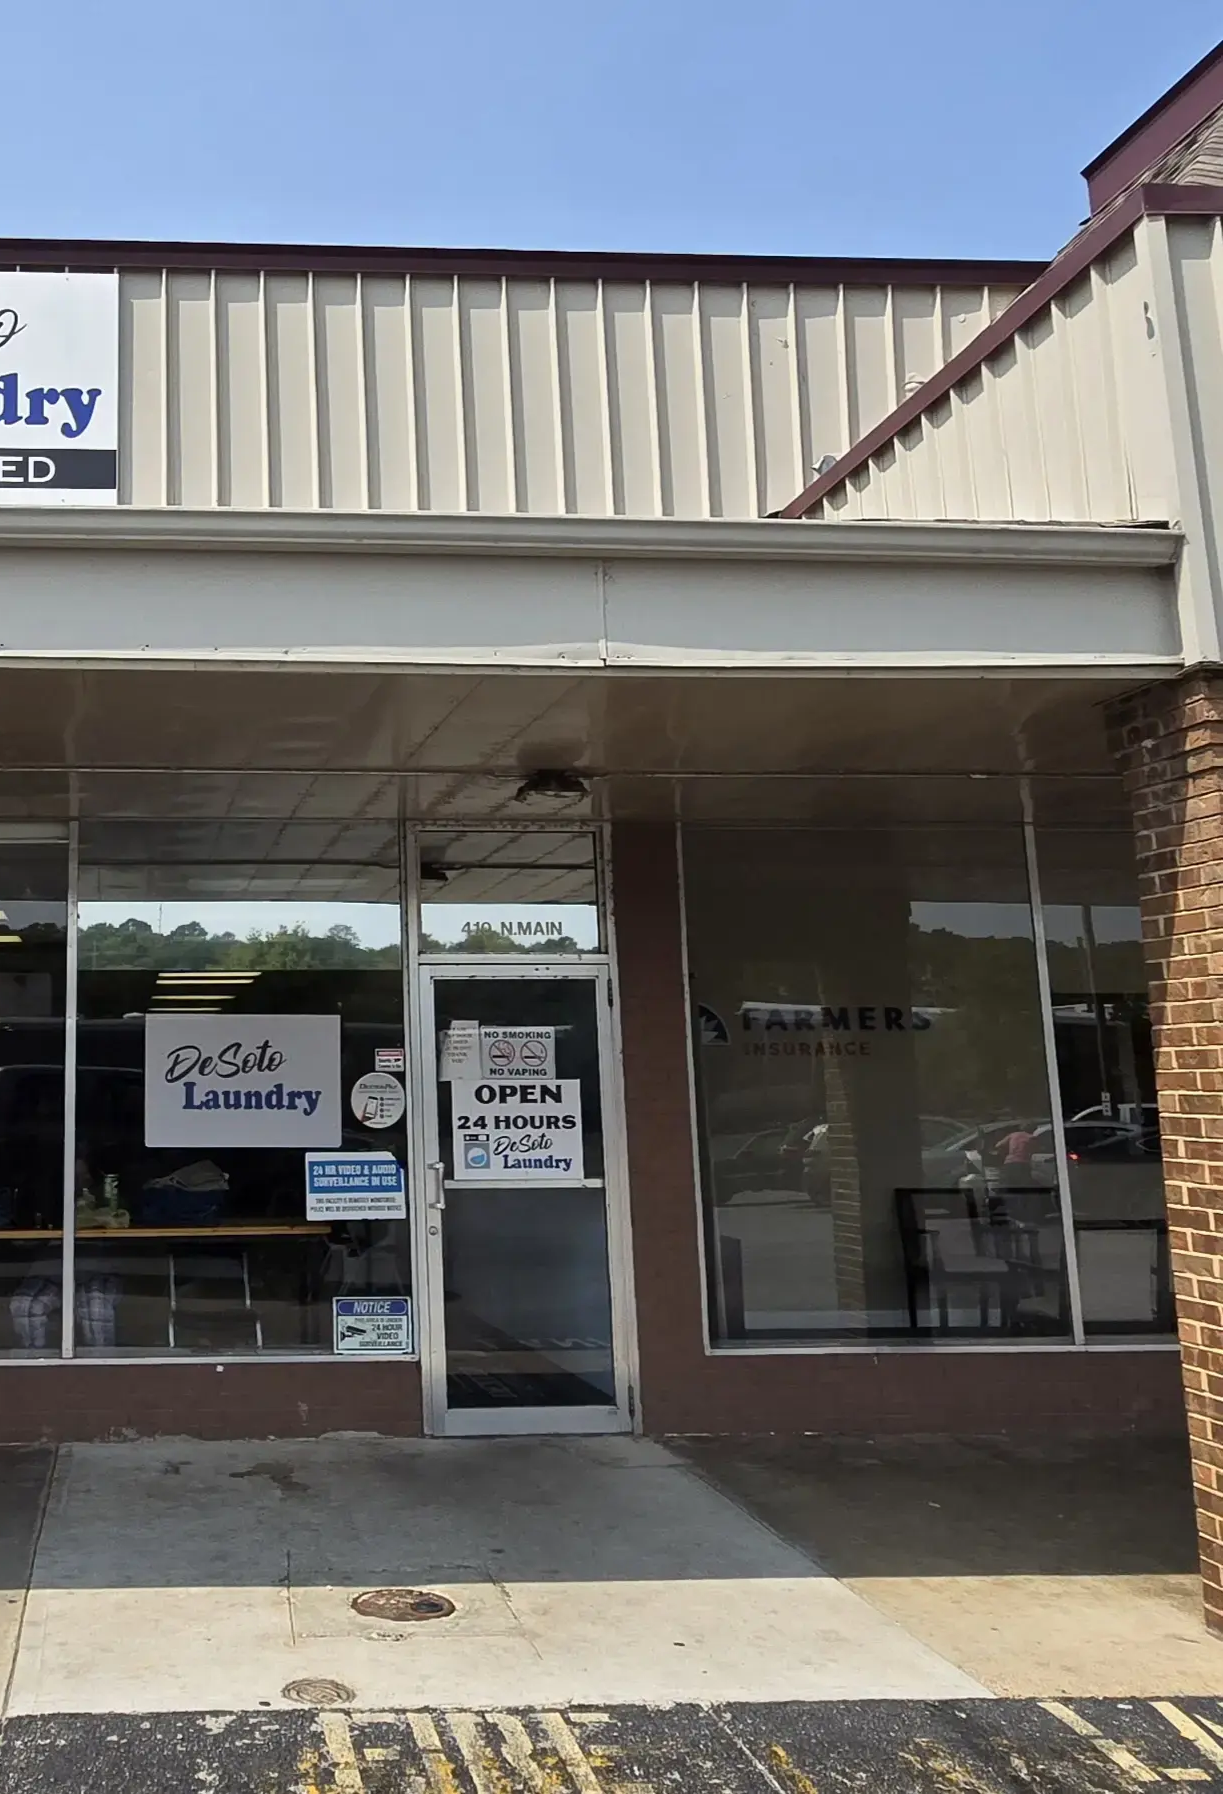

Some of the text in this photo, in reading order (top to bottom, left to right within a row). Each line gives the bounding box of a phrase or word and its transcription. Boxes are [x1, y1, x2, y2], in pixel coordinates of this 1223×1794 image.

[742, 1006, 933, 1032] FARMERS
[502, 1031, 551, 1039] SMOKING
[744, 1042, 870, 1056] INSURANCE
[164, 1039, 287, 1084] DeSoto
[490, 1068, 547, 1076] NO VAPING
[182, 1081, 322, 1116] Laundry
[474, 1084, 562, 1104] OPEN
[457, 1115, 577, 1130] 24 HOURS
[493, 1132, 553, 1156] DeSoto
[313, 1165, 323, 1175] 24
[338, 1165, 361, 1175] VIDEO
[363, 1165, 369, 1174] &
[371, 1164, 396, 1174] AUDIO
[502, 1154, 572, 1172] Laundry
[382, 1176, 397, 1186] USE
[353, 1301, 391, 1313] NOTICE
